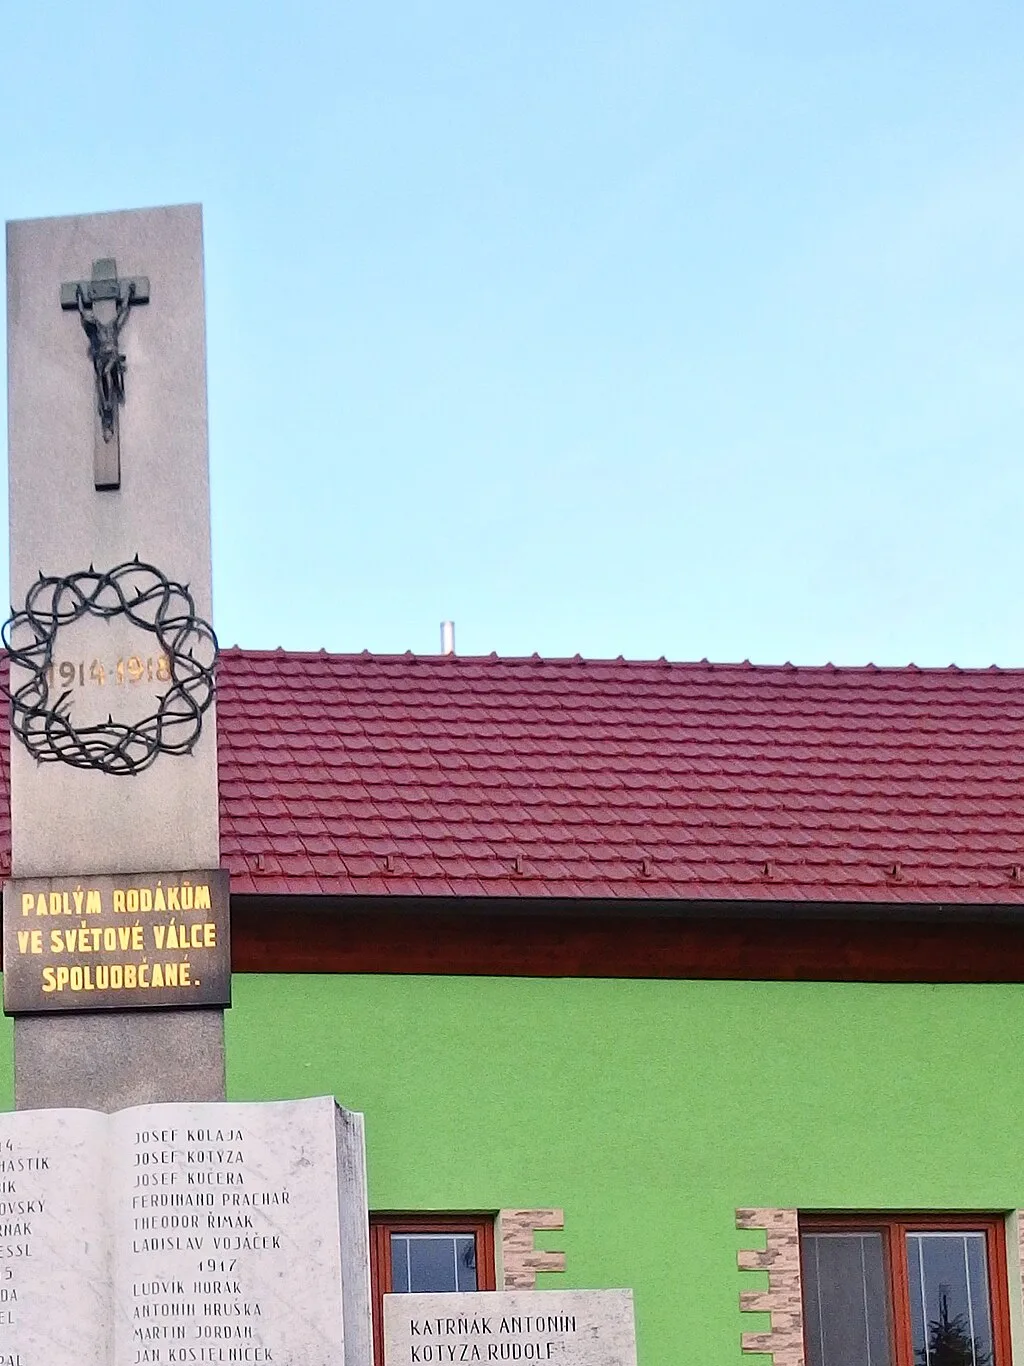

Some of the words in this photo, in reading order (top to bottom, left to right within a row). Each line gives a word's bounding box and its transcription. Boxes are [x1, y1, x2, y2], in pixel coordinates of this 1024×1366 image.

[22, 885, 102, 916] PADLÝM
[113, 881, 212, 913] RODÁKŮM
[17, 931, 43, 954] VE
[50, 920, 144, 953] SVĚTOVÉ
[153, 917, 217, 950] VÁLCE
[42, 954, 201, 993] SPOLUOBČANÉ.
[134, 1130, 179, 1144] JOSEF
[187, 1128, 245, 1142] KOLAJA
[134, 1150, 179, 1167] JOSEF
[134, 1172, 178, 1188] JOSEF
[187, 1168, 245, 1185] KUČERA
[132, 1193, 214, 1209] FERDINAND
[222, 1187, 290, 1206] PRACHAŘ
[134, 1215, 200, 1231] THEODOR
[133, 1237, 204, 1253] LADISLAV
[213, 1231, 281, 1250] VOJÁČEK
[198, 1259, 237, 1273] 1917
[410, 1312, 492, 1335] KATRŇÁK
[499, 1310, 576, 1334] ANTONÍN
[133, 1326, 186, 1342] MARTIN
[134, 1349, 161, 1364] JAN
[410, 1344, 481, 1362] KOTYZA
[488, 1342, 555, 1361] RUDOLF
